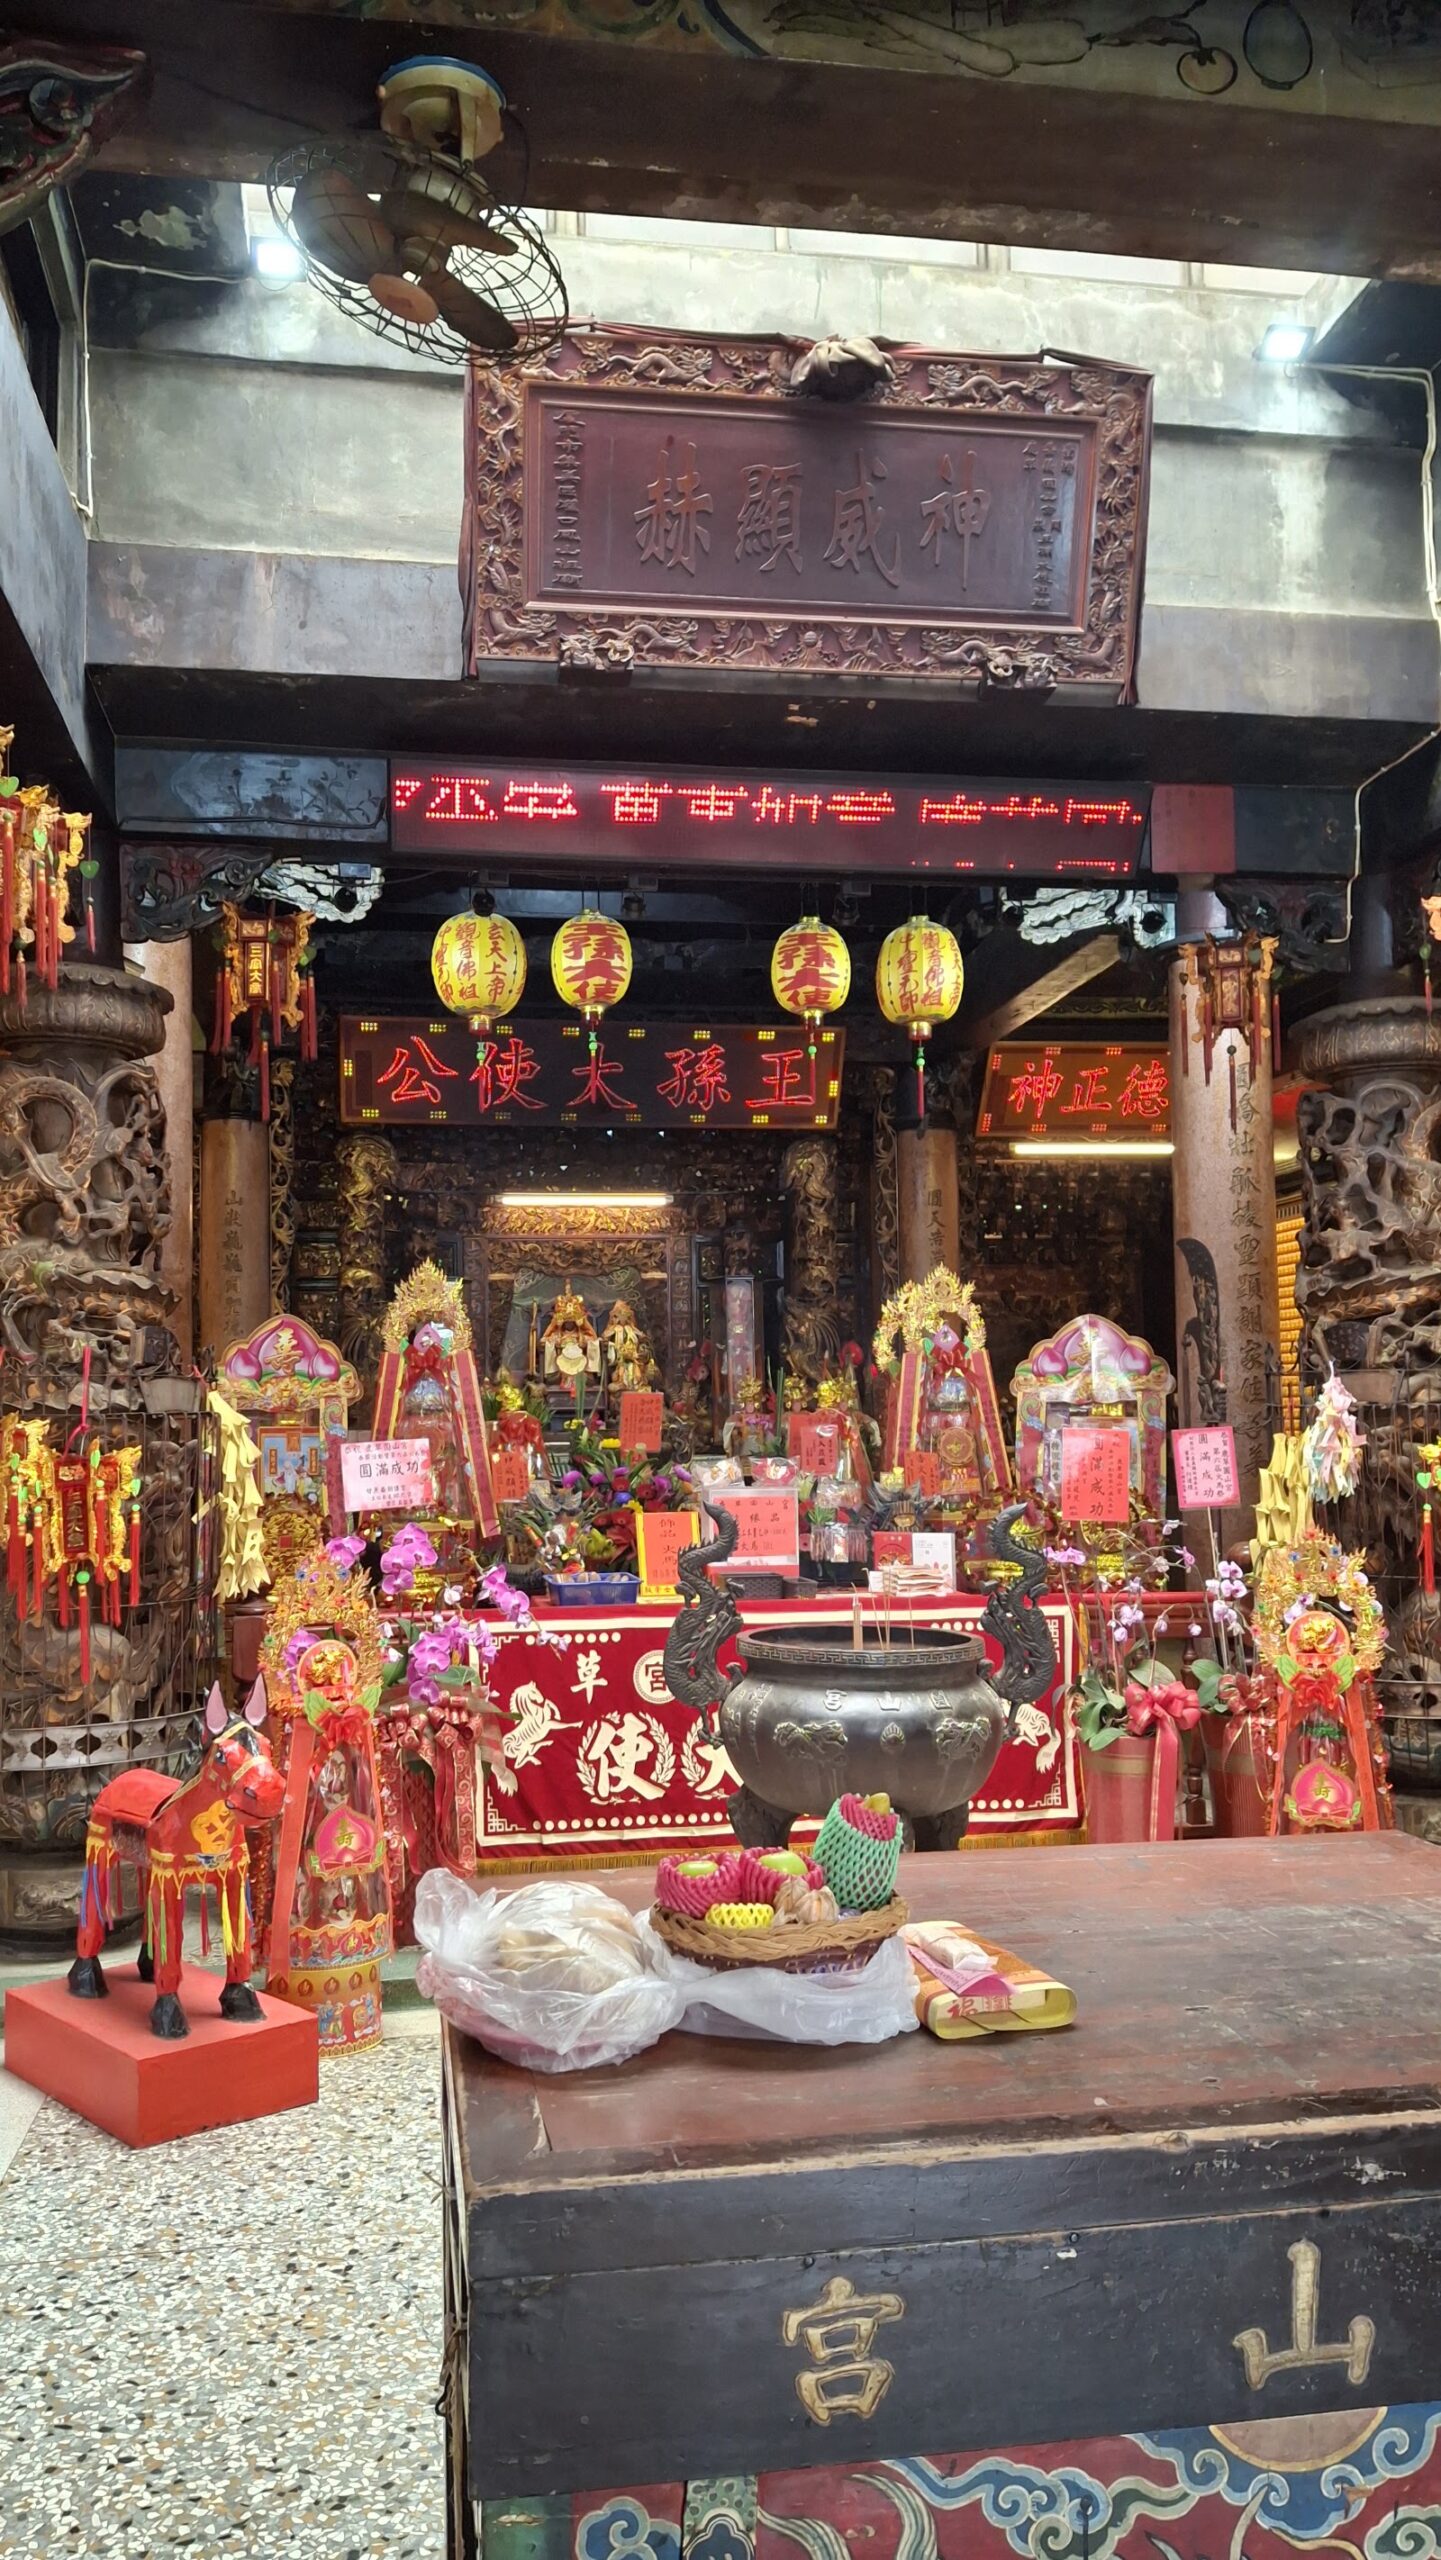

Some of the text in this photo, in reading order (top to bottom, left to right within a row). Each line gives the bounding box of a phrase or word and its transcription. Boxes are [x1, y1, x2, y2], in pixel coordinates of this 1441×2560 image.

[484, 921, 508, 1004] 玄天上帝
[359, 1460, 419, 1478] 圓滿成功
[1198, 1433, 1214, 1498] 圓滿成功
[570, 1649, 608, 1704] 草
